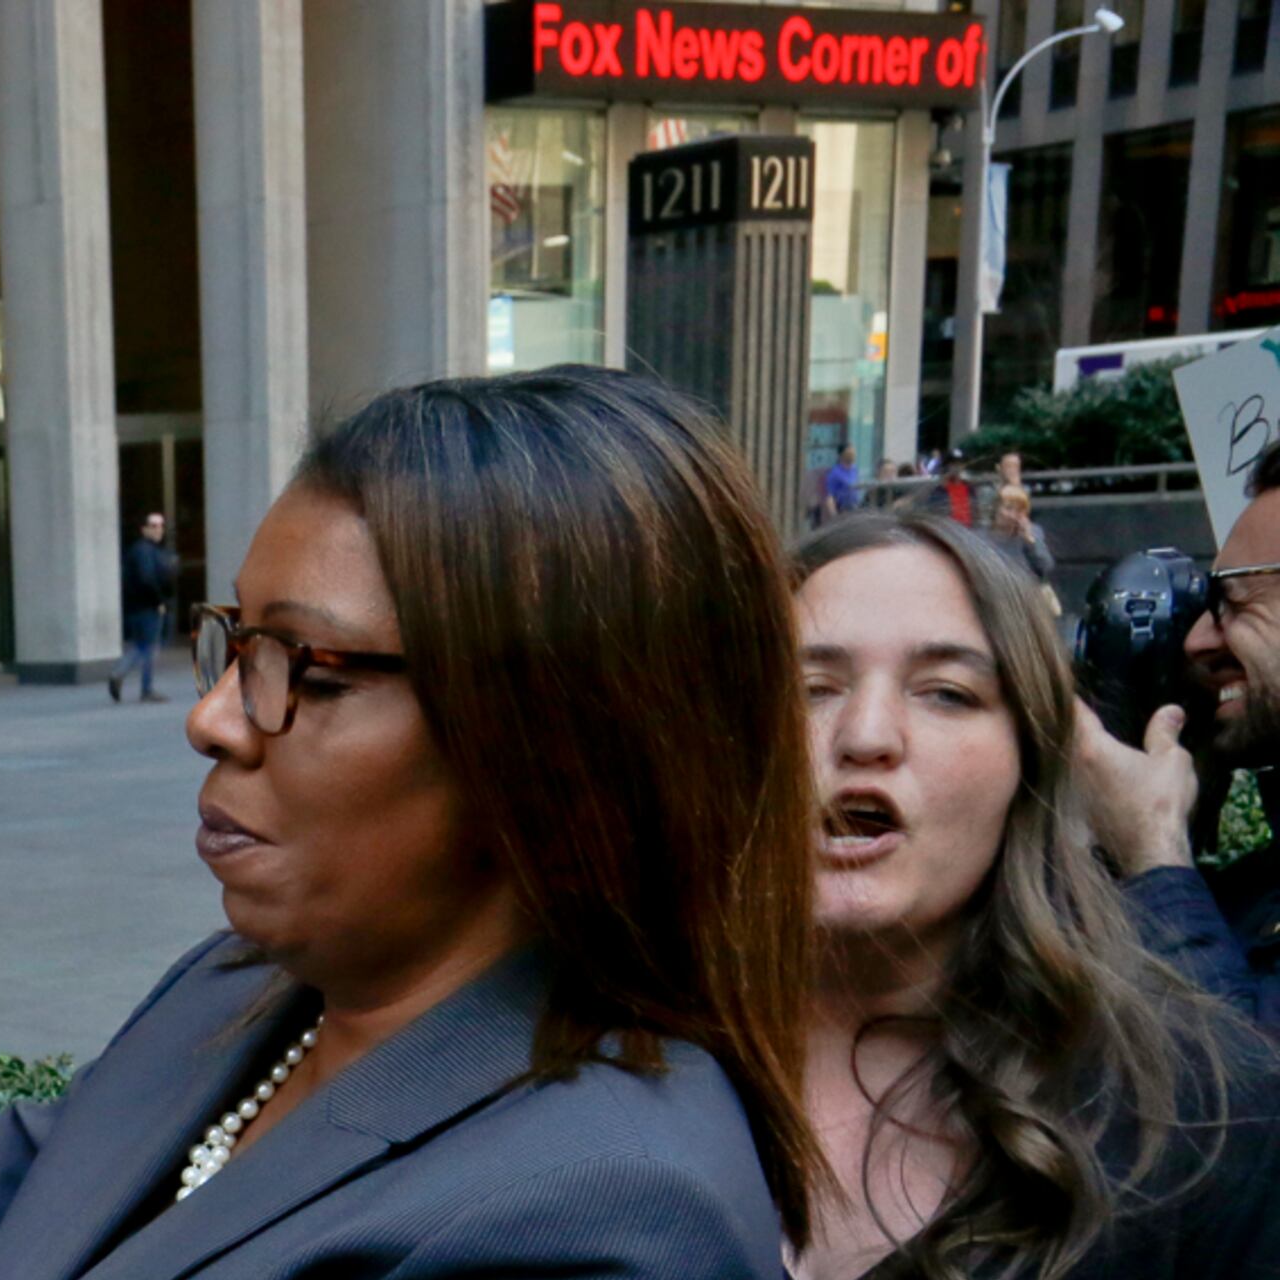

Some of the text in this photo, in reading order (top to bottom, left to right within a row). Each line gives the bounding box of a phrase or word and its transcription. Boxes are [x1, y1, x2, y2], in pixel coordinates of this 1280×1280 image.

[533, 2, 982, 88] Fox News Corner of
[642, 160, 722, 221] 1211
[750, 155, 810, 210] 1211
